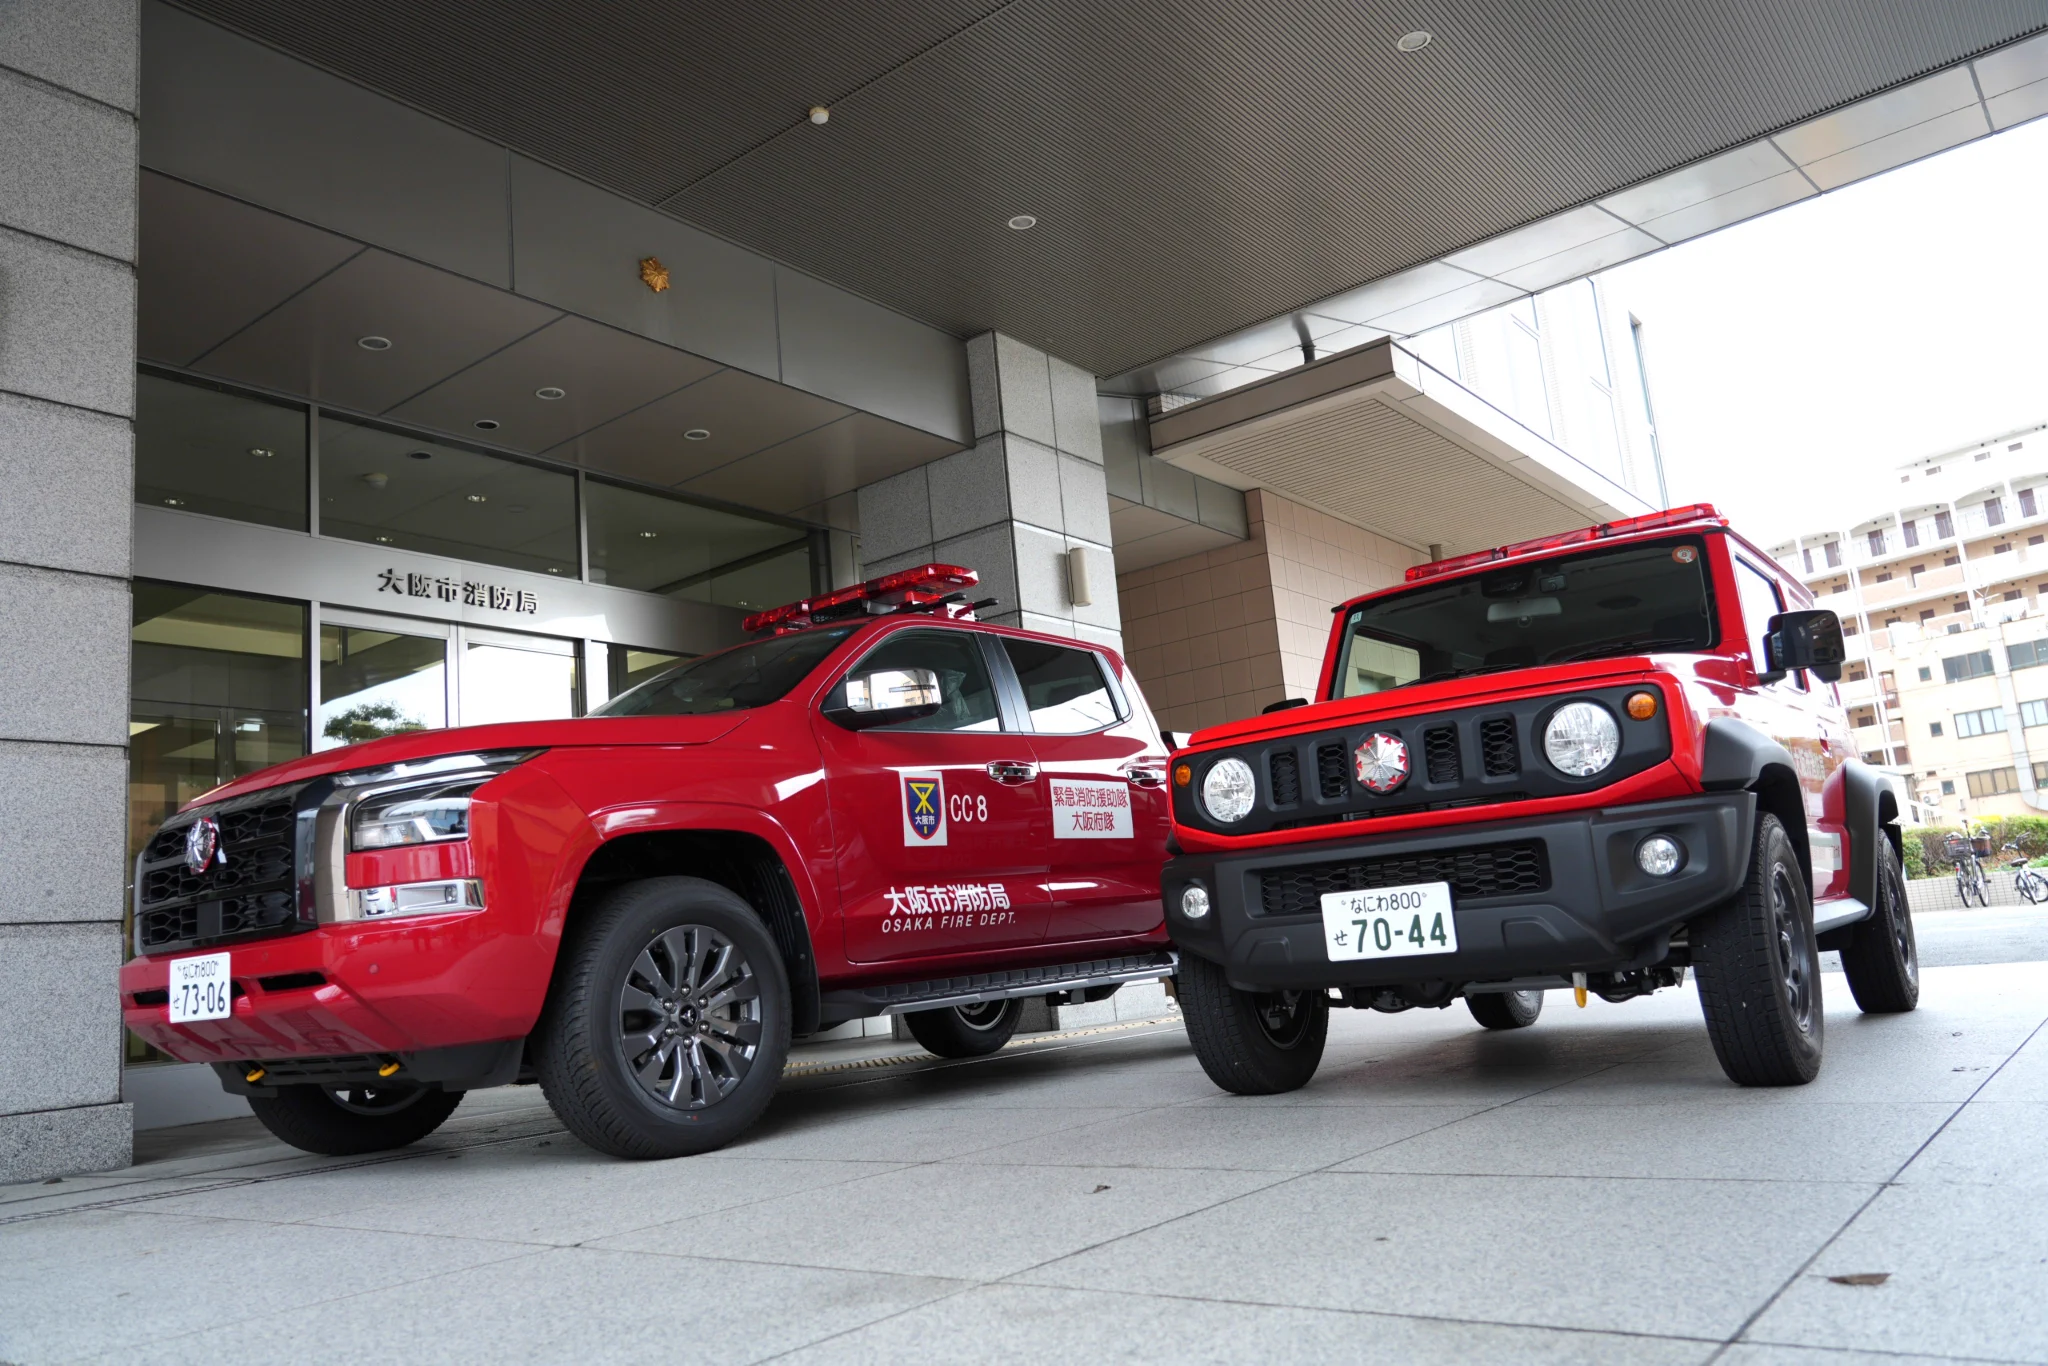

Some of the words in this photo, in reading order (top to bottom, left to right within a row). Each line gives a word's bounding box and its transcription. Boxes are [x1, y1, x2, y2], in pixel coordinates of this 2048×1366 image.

[377, 568, 540, 614] 大阪市消防局
[950, 794, 973, 822] CC
[977, 794, 988, 822] 8
[1053, 786, 1128, 808] 緊急消防援助隊
[915, 815, 935, 825] 大阪市
[1072, 811, 1115, 831] 大阪府隊
[883, 883, 1010, 916] 大阪市消防局
[882, 917, 933, 933] OSAKA
[941, 914, 973, 929] FIRE
[980, 912, 1016, 926] DEPT.
[1333, 930, 1348, 946] せ
[1351, 912, 1448, 953] 70-44
[182, 981, 225, 1016] 73-06
